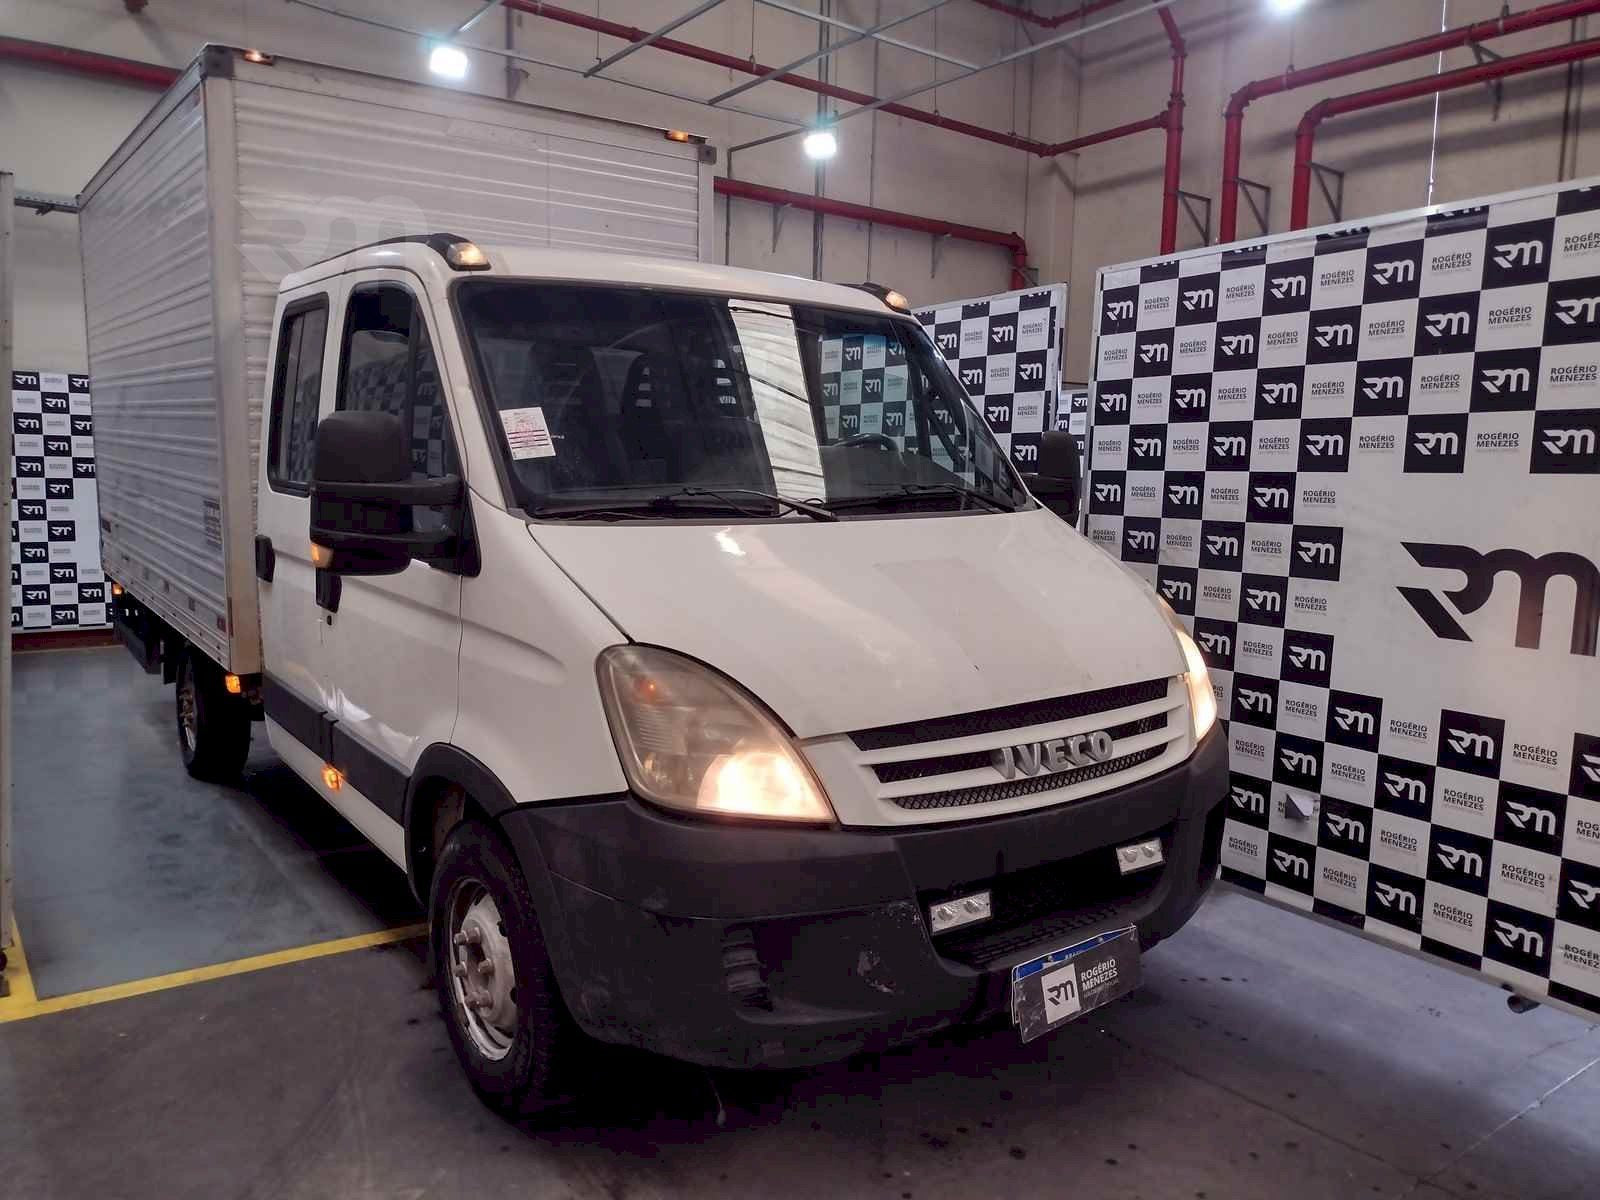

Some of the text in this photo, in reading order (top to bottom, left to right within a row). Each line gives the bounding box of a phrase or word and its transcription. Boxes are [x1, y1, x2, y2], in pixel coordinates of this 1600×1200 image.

[1431, 258, 1471, 271] MENEZES
[1488, 313, 1531, 324] MENEZES
[1368, 326, 1404, 336] MENEZES
[1420, 380, 1459, 389] MENEZES
[1550, 372, 1597, 382] MENEZES
[1389, 725, 1426, 739] MENEZES
[998, 730, 1114, 780] IVECO
[1513, 749, 1557, 765] MENEZES
[1443, 795, 1483, 811] MENEZES
[1380, 835, 1416, 852] MENEZES
[1501, 869, 1544, 888] MENEZES
[1433, 908, 1472, 927] MENEZES
[1081, 958, 1116, 981] ROGÉRIO
[1082, 967, 1118, 991] MENEZES
